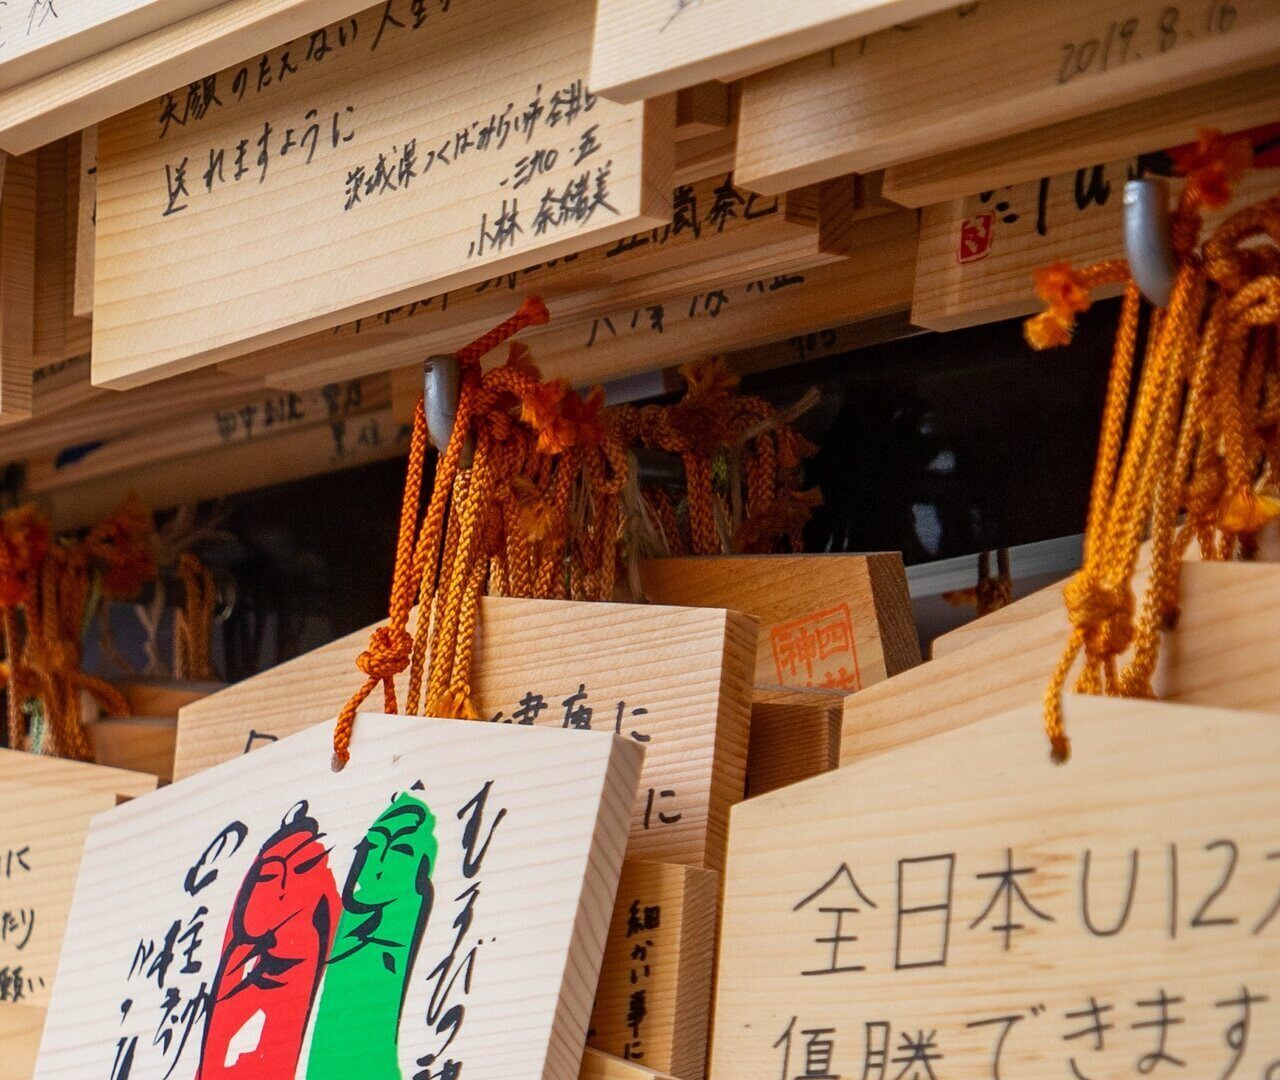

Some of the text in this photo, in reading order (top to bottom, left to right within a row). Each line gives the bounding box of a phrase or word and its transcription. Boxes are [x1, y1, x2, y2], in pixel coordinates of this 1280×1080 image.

[159, 0, 450, 139] 笑顔のたえない人生
[162, 106, 356, 217] 送れますように
